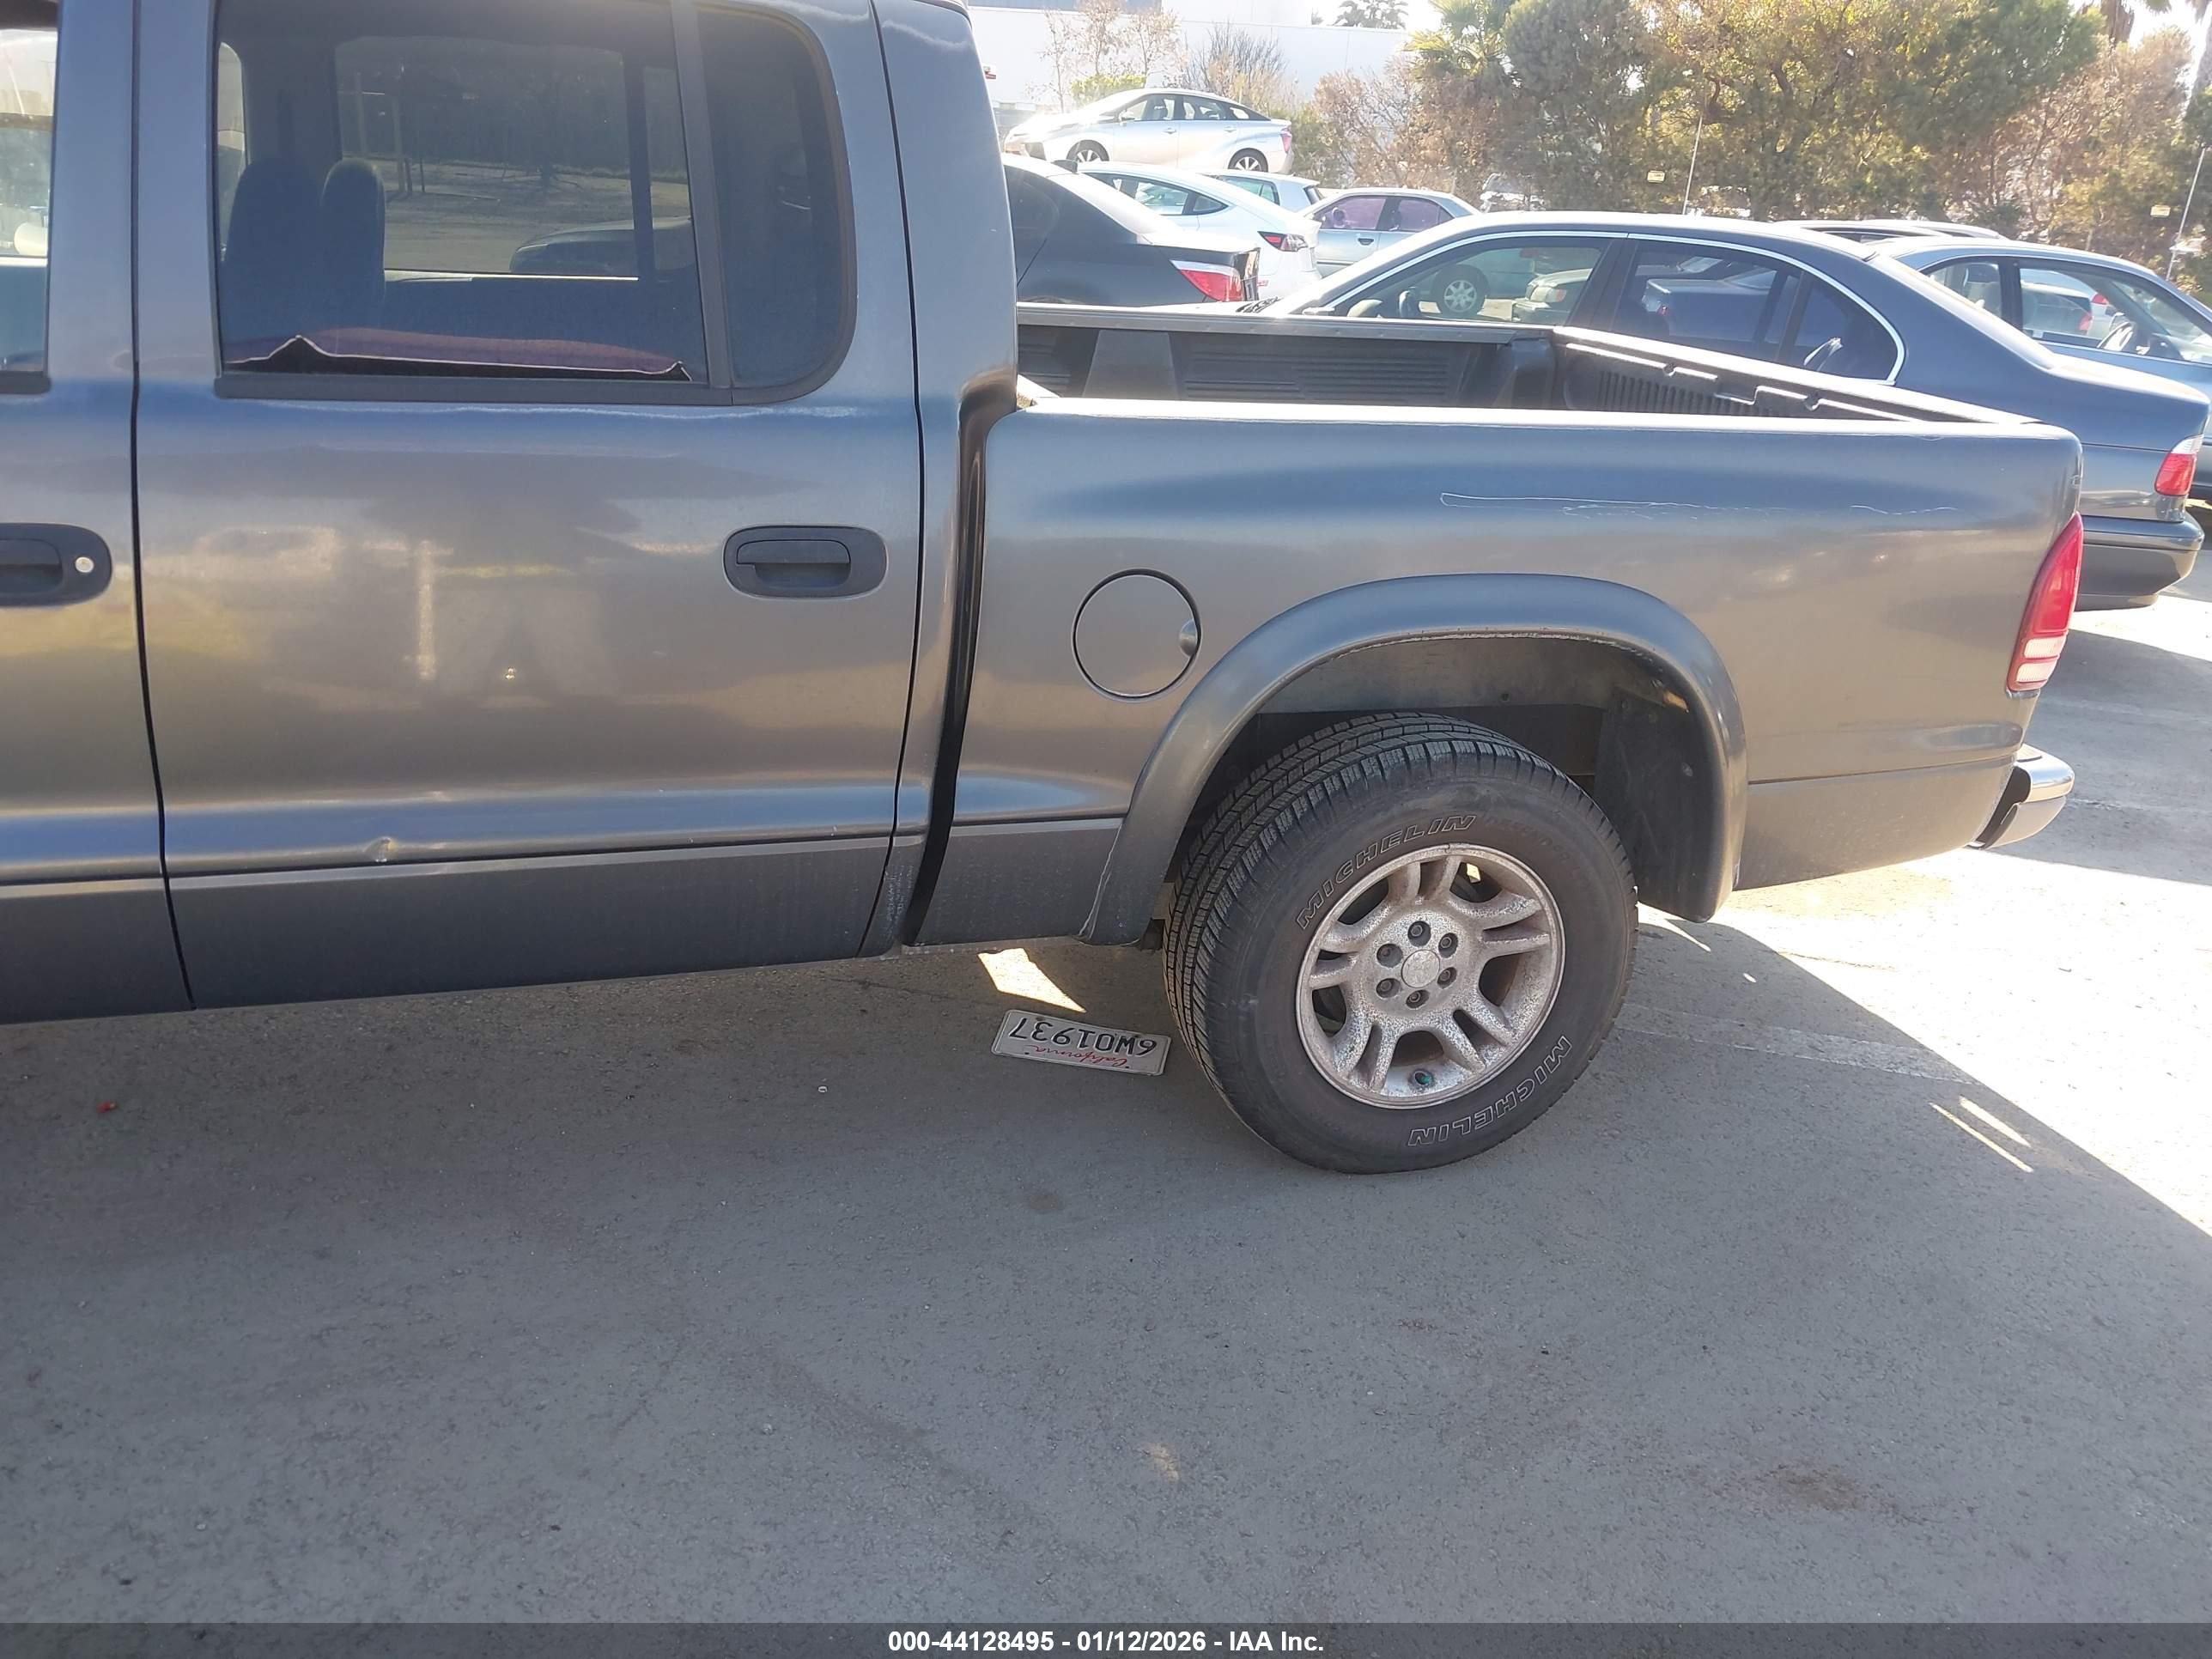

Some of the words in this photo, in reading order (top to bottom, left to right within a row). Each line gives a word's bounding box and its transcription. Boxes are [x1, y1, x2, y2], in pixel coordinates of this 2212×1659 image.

[1295, 814, 1478, 930] MICHELIN
[1009, 1018, 1158, 1056] 6W01937
[1027, 1044, 1127, 1067] California
[1407, 1035, 1573, 1146] MICHELIN
